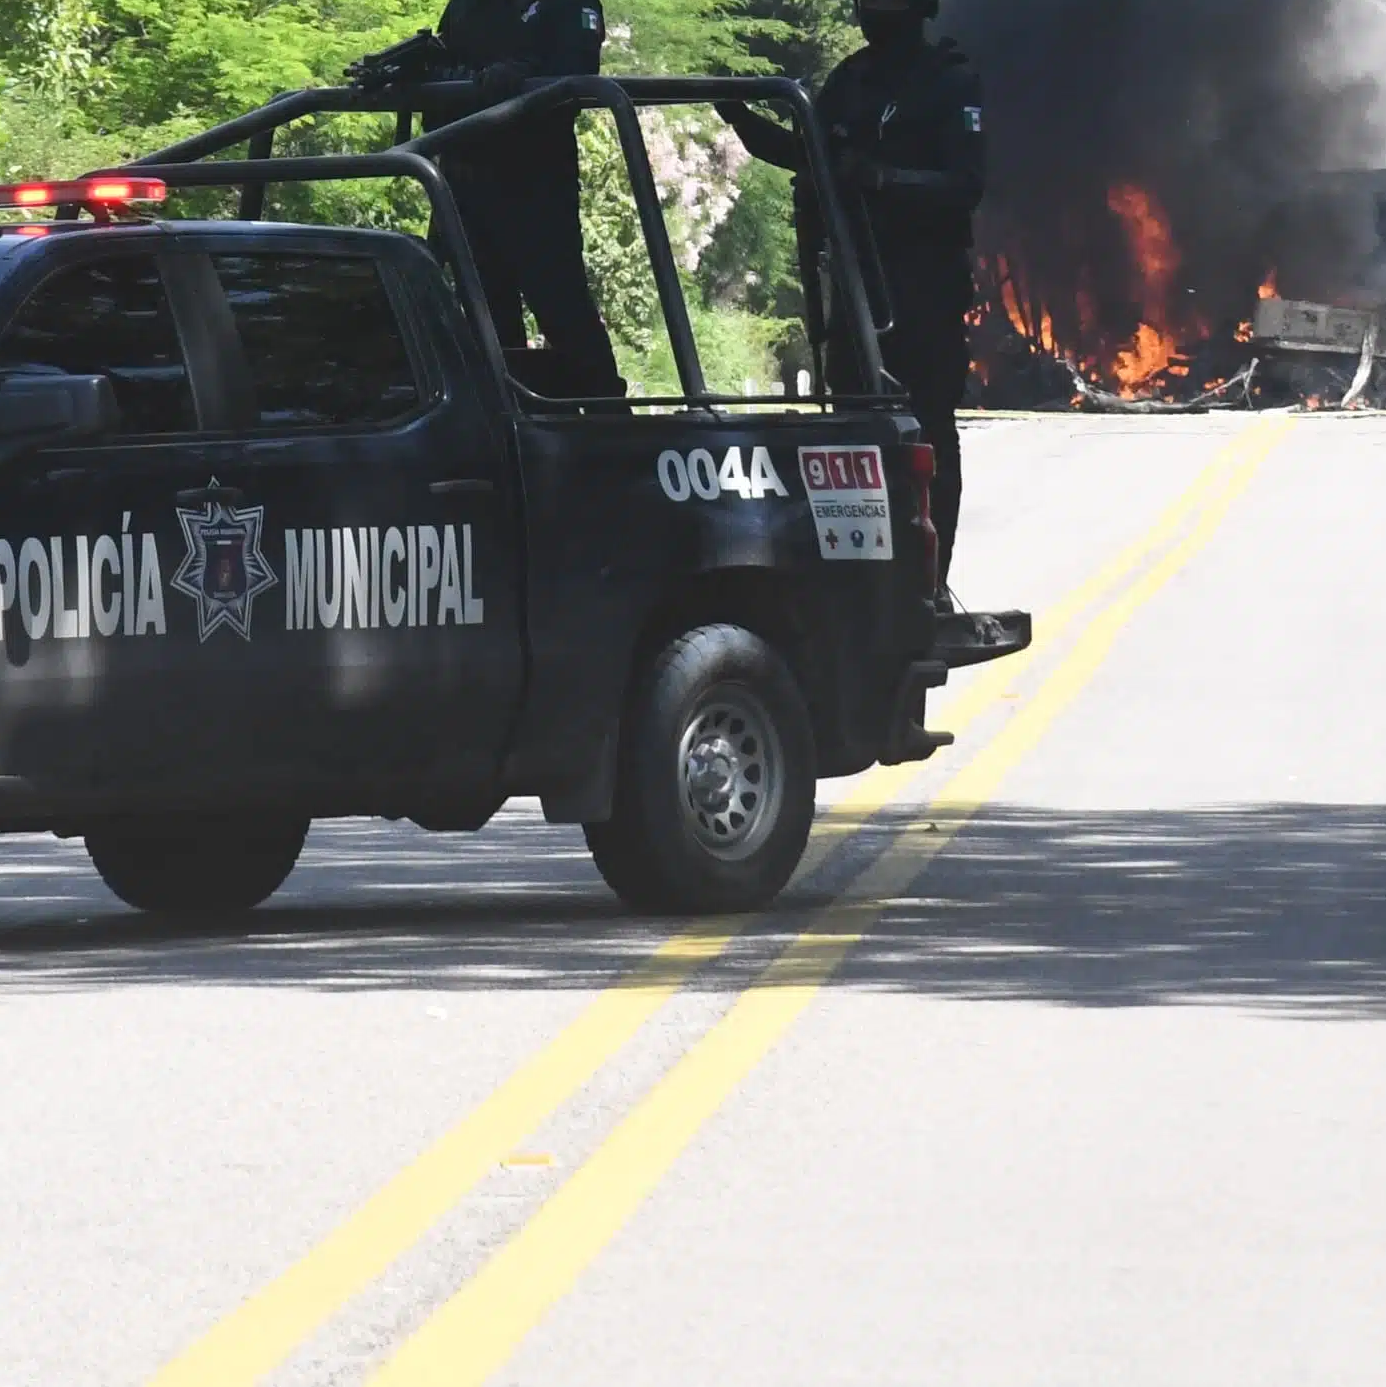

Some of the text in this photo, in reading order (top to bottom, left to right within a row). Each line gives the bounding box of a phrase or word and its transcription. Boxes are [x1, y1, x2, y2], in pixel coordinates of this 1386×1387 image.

[657, 445, 790, 502] 004A
[809, 458, 874, 486] 911
[816, 506, 886, 518] EMERGENCIAS
[284, 523, 485, 631] MUNICIPAL
